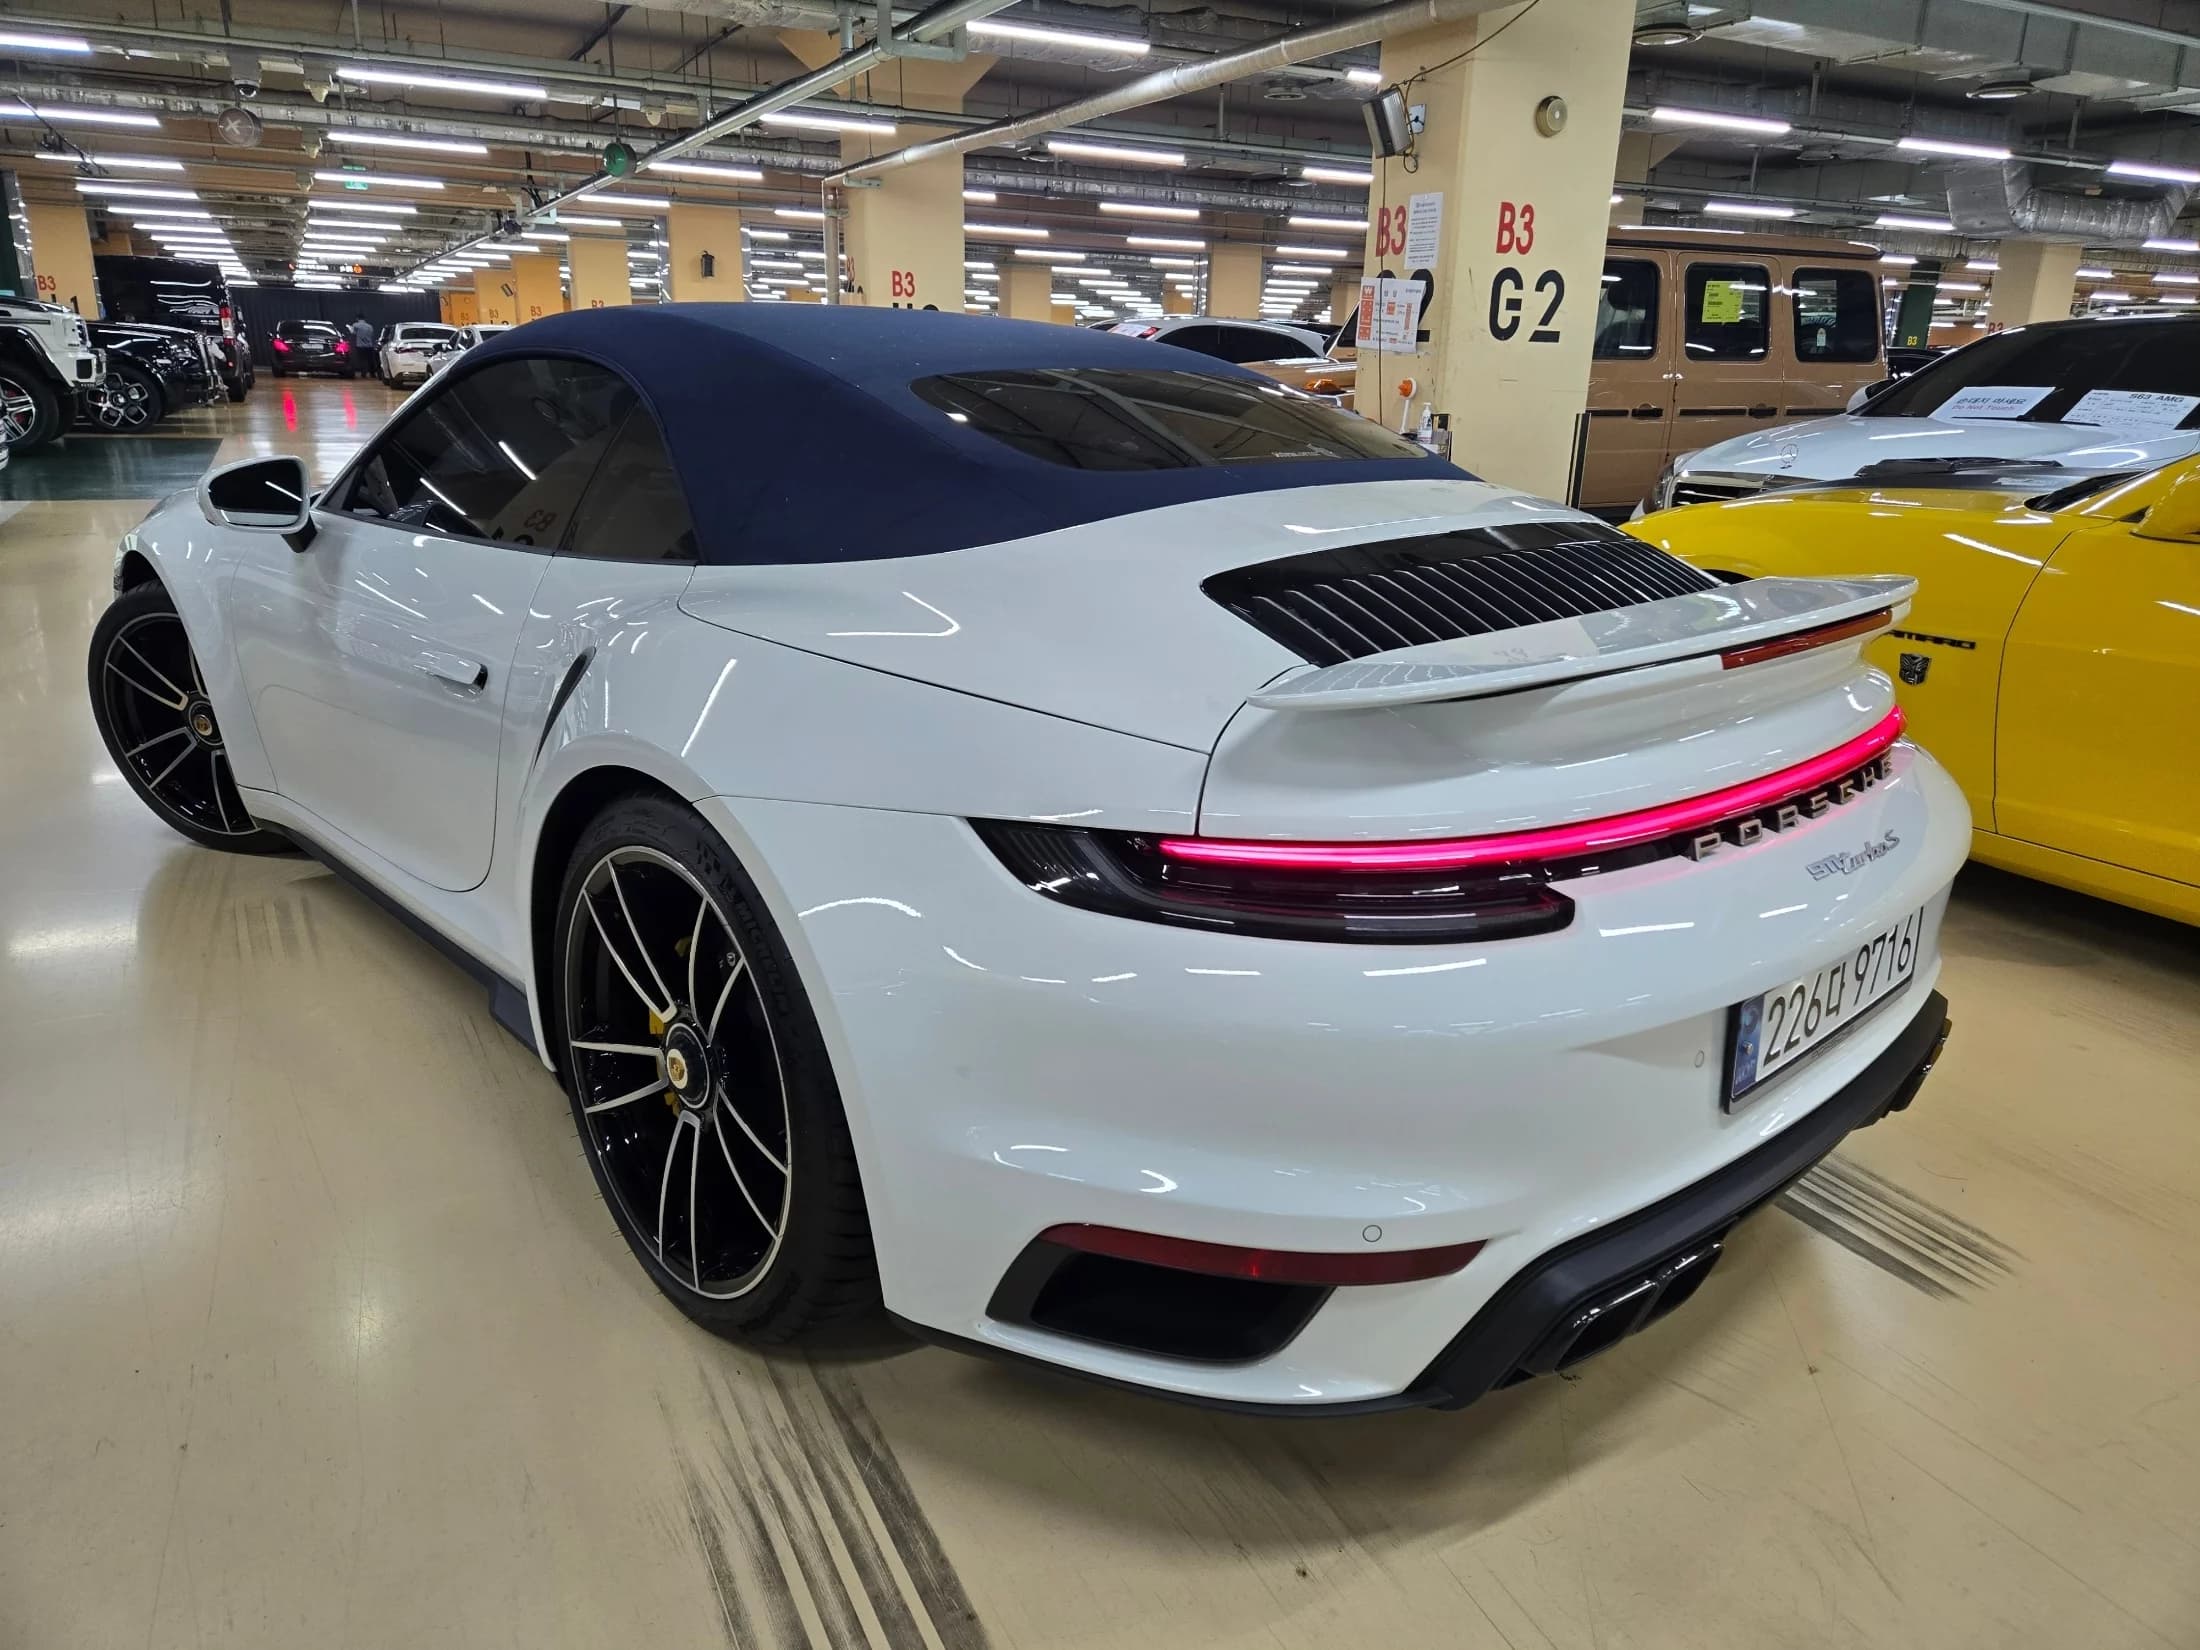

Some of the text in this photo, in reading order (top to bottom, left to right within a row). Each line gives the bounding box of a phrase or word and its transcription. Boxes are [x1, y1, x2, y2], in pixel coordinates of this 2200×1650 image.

[1376, 205, 1407, 257] B3
[1496, 201, 1535, 255] B3
[38, 275, 56, 291] B3
[891, 270, 915, 297] B3
[530, 305, 542, 316] B3
[1489, 267, 1565, 343] G2
[1907, 336, 1918, 346] B3
[2156, 395, 2185, 403] AMG
[1690, 755, 1893, 862] PORSCHE
[1763, 914, 1912, 1068] 226다 9716
